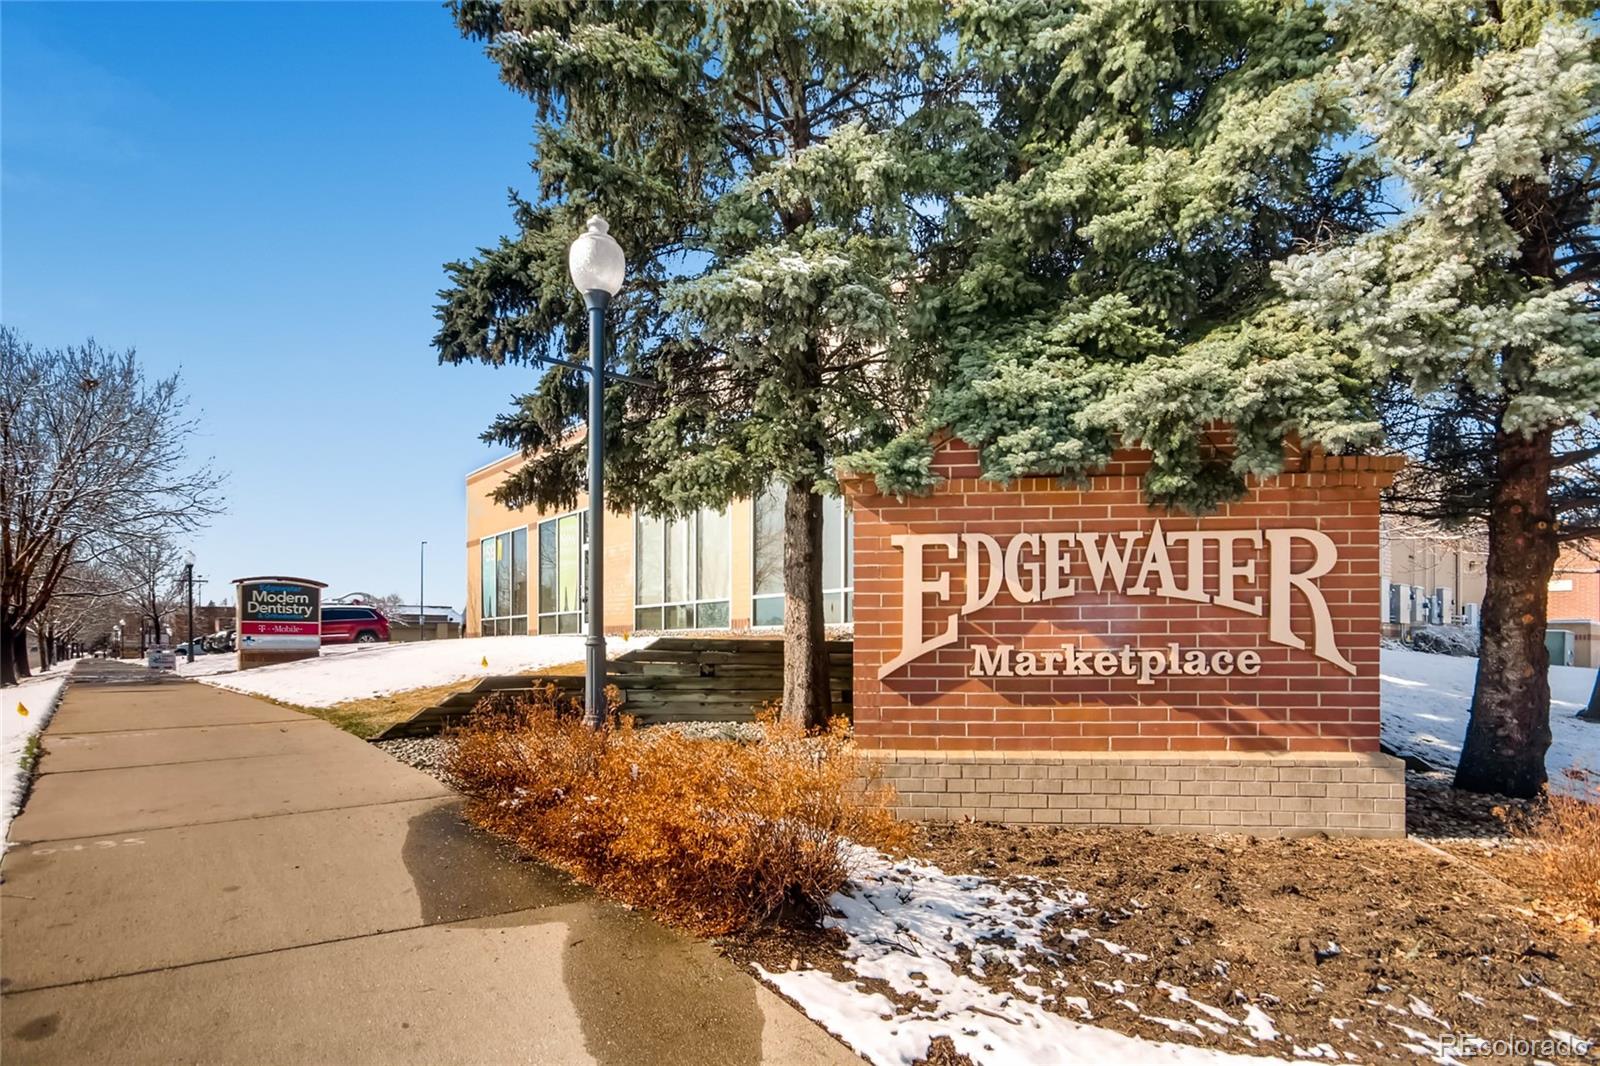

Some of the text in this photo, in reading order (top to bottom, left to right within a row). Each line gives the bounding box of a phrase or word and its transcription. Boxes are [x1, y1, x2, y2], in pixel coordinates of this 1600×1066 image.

[247, 602, 313, 618] Dentistry
[252, 590, 309, 603] Modern
[878, 519, 1357, 681] EDGEWATER
[970, 643, 1261, 685] Marketplace
